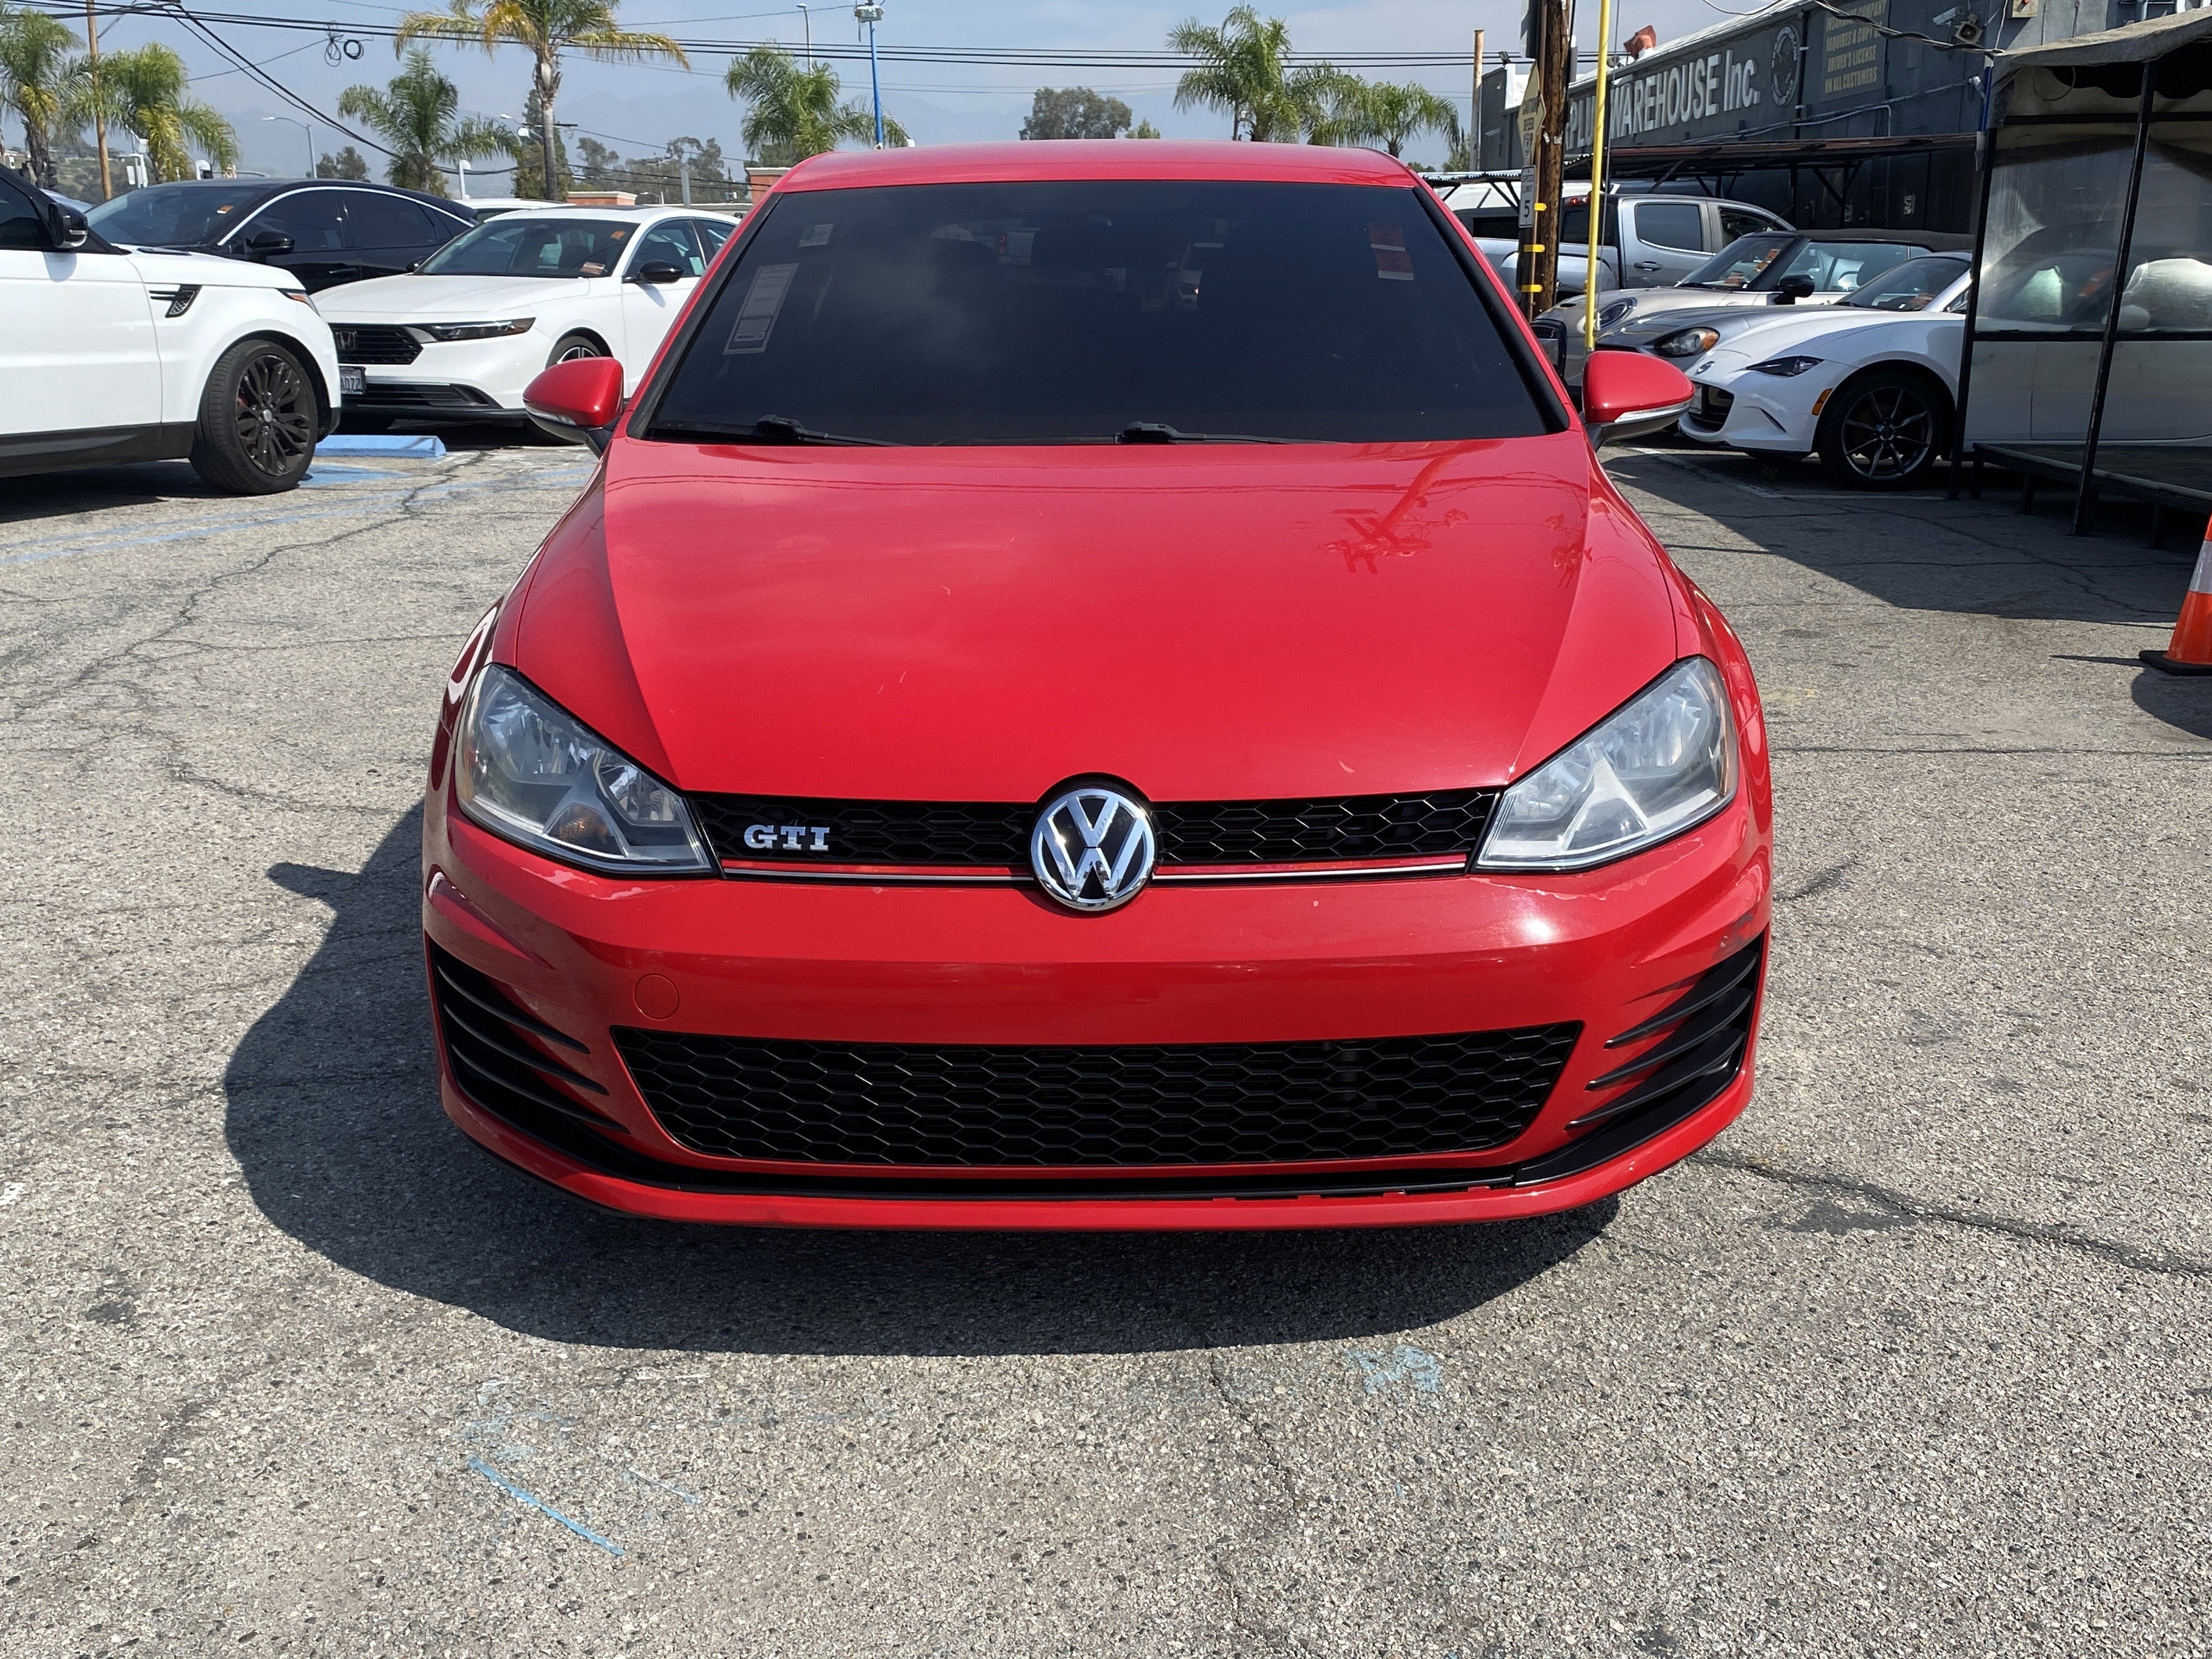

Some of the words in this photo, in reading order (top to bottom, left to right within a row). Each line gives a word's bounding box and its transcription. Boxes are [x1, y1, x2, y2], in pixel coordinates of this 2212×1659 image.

[1853, 44, 1877, 65] LICENSE
[1825, 78, 1832, 94] ON
[1843, 66, 1877, 89] CUSTOMERS
[1610, 54, 1722, 139] WAREHOUSE
[1724, 49, 1761, 111] Inc.
[1523, 200, 1530, 218] 5
[744, 824, 830, 851] GTI
